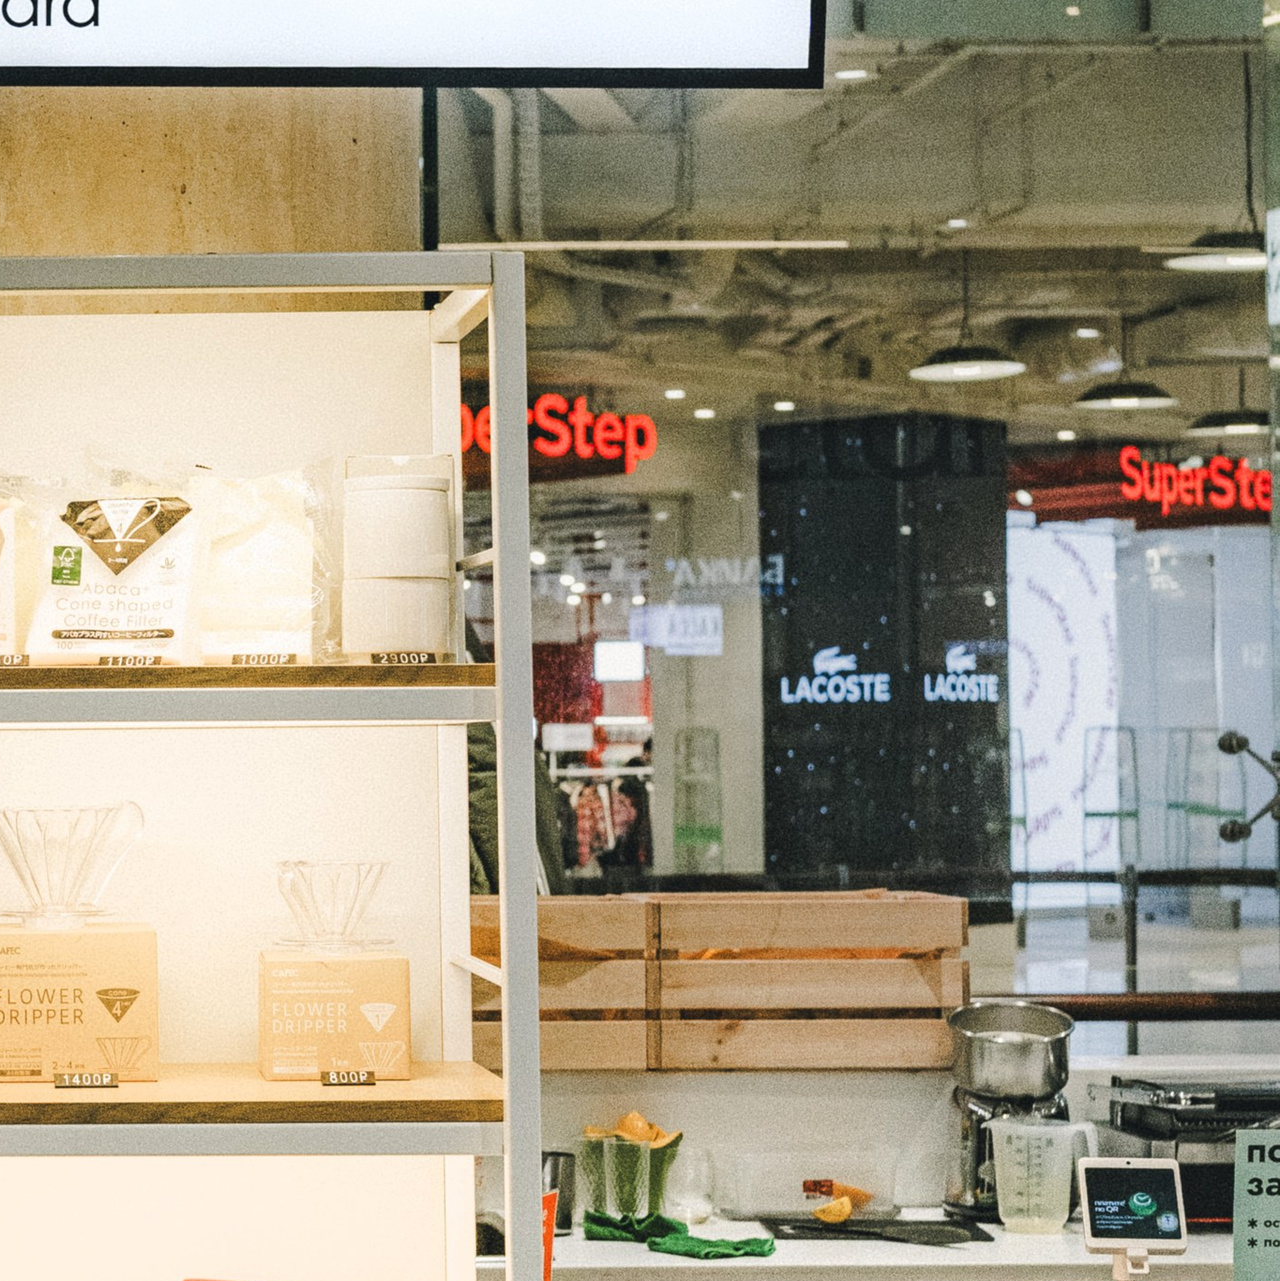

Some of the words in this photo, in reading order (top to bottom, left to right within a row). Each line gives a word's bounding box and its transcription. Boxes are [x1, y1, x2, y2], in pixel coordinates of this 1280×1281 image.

[56, 598, 102, 610] Cone
[108, 598, 173, 613] shaped
[63, 613, 120, 627] Coffee
[126, 613, 164, 627] Filter
[781, 674, 891, 703] LACOSTE
[924, 674, 999, 702] LACOSTE
[272, 1002, 348, 1017] FLOWER
[272, 1020, 348, 1034] DRIPPER
